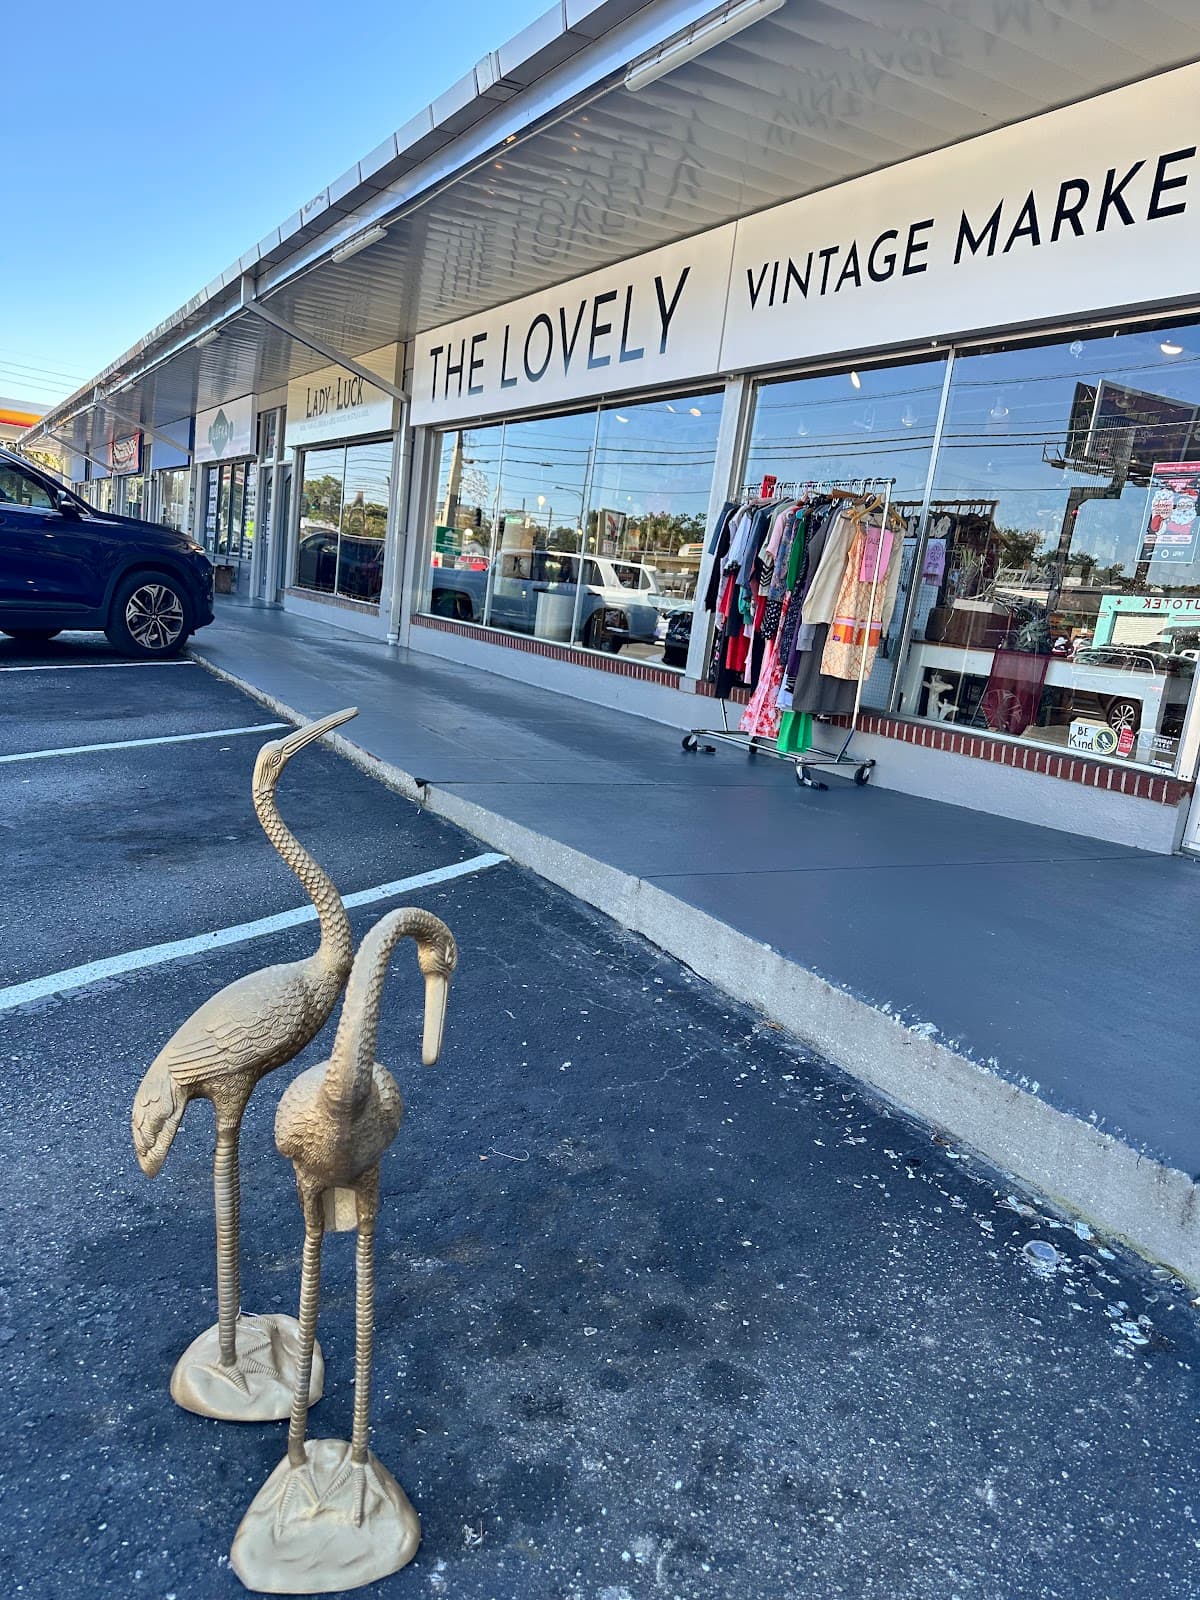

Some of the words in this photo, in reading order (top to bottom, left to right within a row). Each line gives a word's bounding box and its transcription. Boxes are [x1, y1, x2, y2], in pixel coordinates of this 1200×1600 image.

[430, 332, 488, 402] THE
[500, 266, 691, 389] LOVELY
[747, 218, 935, 311] VINTAGE
[306, 386, 331, 418] LADY
[336, 376, 363, 410] LUCK
[1070, 734, 1094, 751] Kind
[1077, 726, 1089, 737] BE
